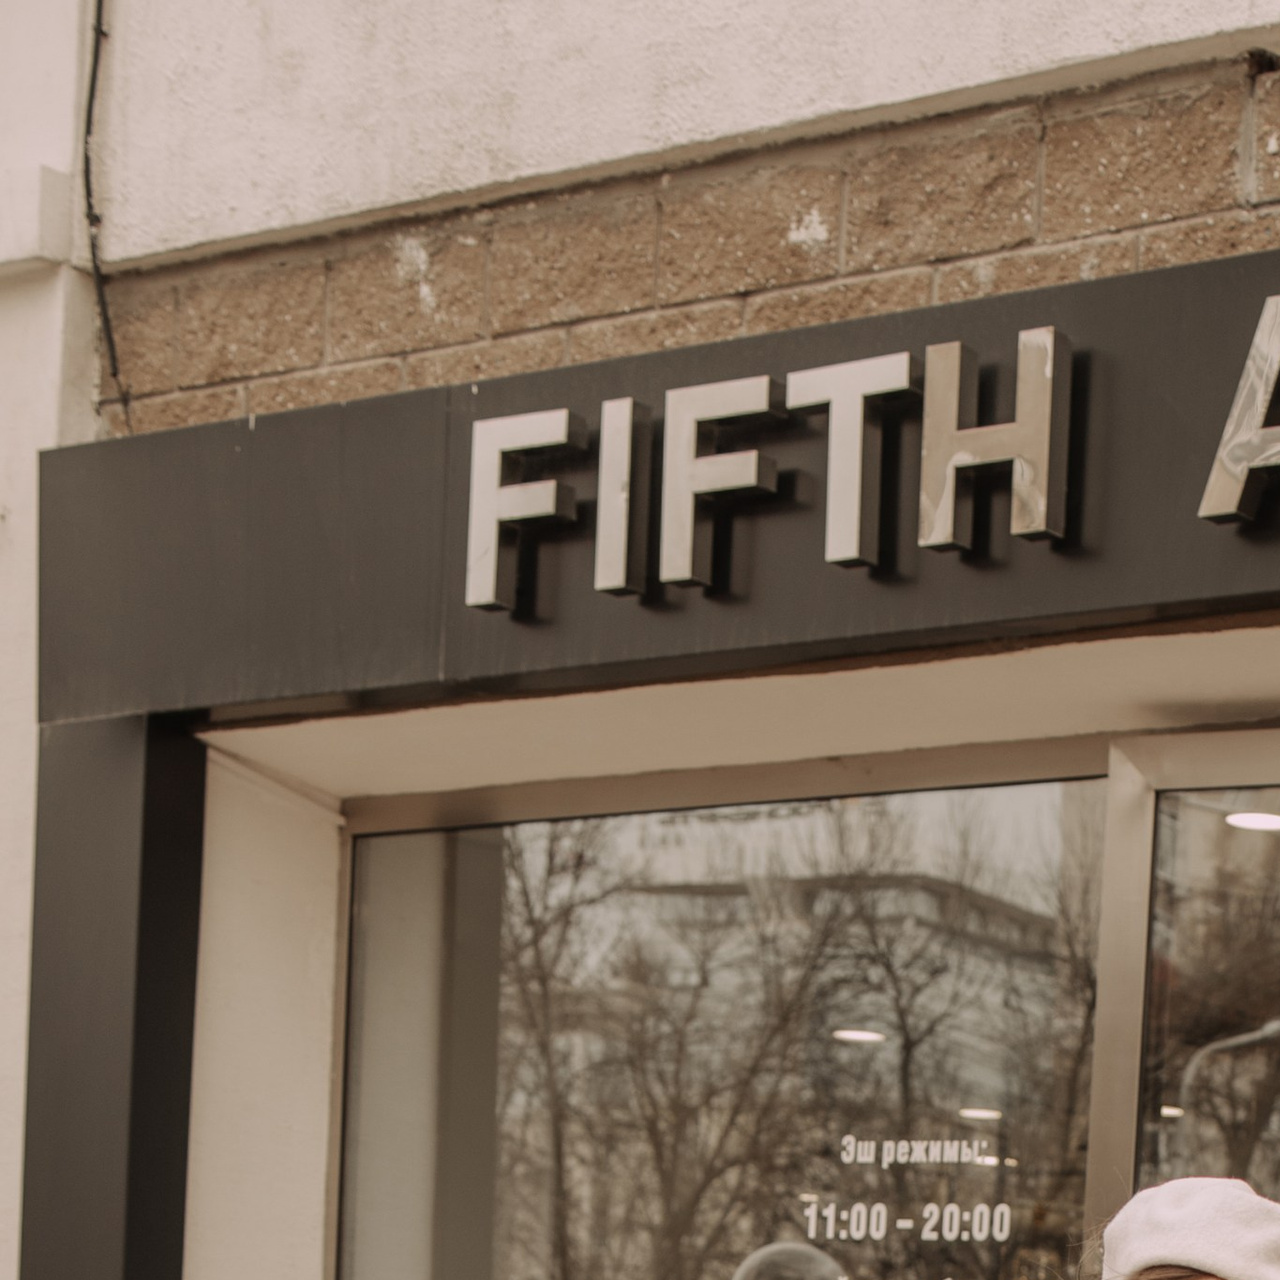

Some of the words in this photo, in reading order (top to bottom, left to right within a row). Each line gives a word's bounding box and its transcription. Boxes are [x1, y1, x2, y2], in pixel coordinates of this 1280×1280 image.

[465, 325, 1072, 612] FIFTH
[840, 1133, 877, 1165] Эш
[881, 1138, 989, 1170] режимы:
[802, 1202, 888, 1241] 11:00
[920, 1202, 1012, 1242] 20:00
